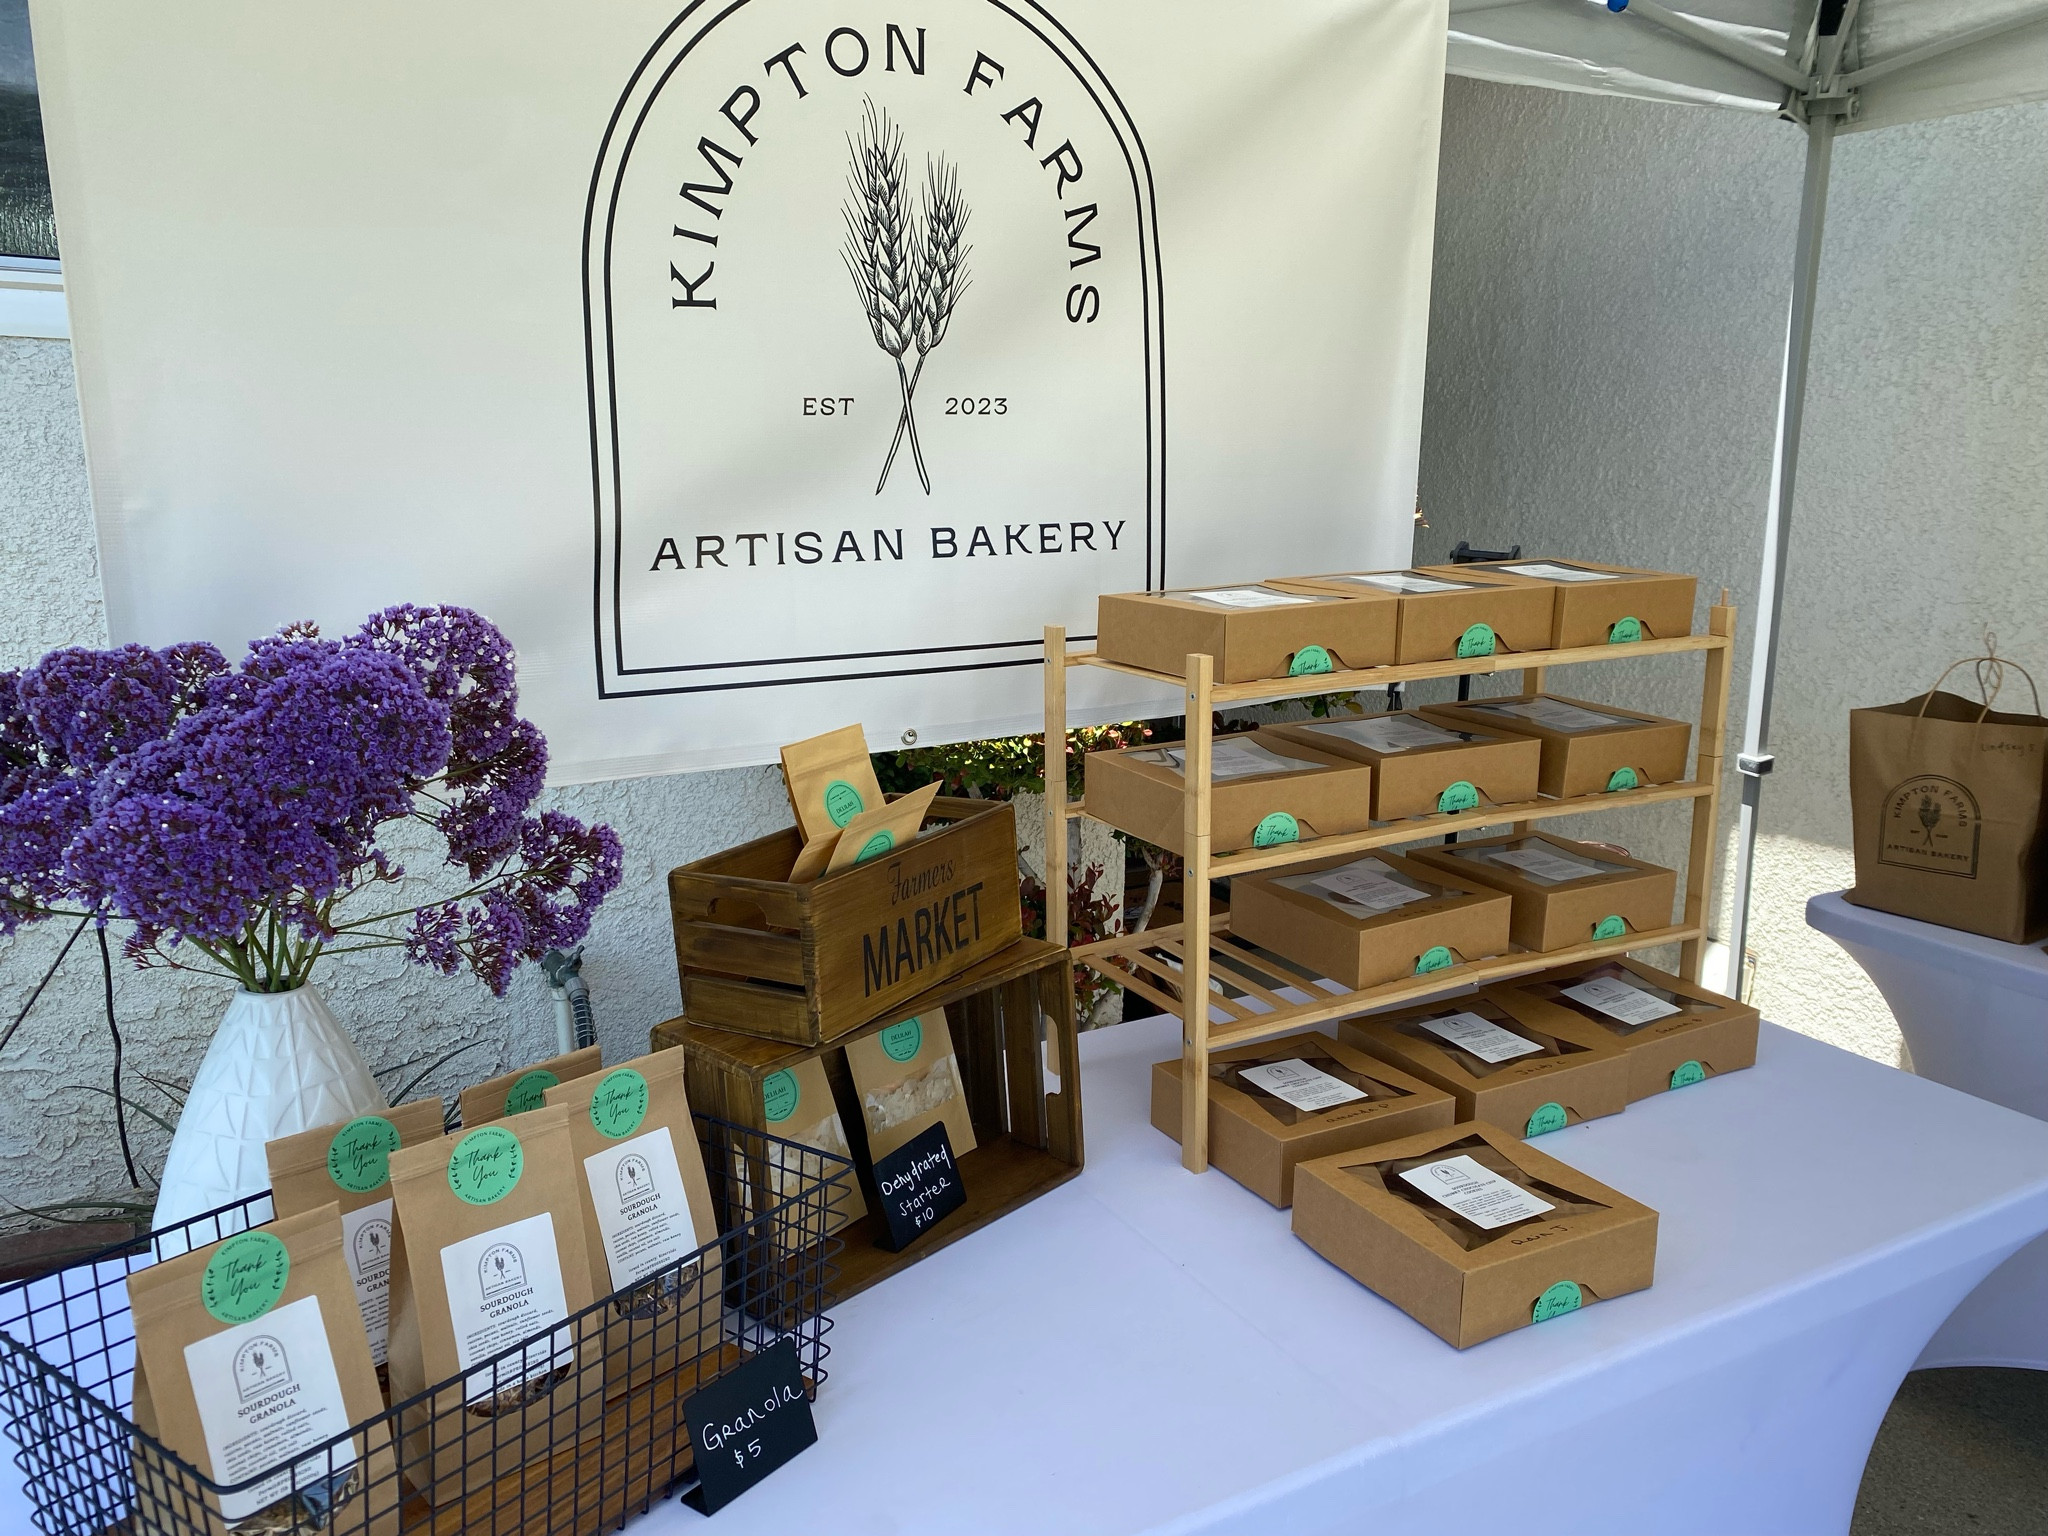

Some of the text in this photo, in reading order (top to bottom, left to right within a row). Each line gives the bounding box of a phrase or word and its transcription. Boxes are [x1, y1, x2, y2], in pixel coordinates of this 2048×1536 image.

[670, 23, 1102, 324] KIMPTON FARMS
[802, 397, 1009, 416] EST 2023
[649, 519, 1127, 572] ARTISAN BAKERY
[1893, 785, 1968, 827] KIMPTON FARMS
[1267, 825, 1288, 837] Thank
[1887, 844, 1970, 862] ARTISAN BAKERY
[887, 860, 956, 906] Farmers
[863, 881, 984, 998] MARKET
[604, 1086, 634, 1107] Thank
[609, 1103, 630, 1125] You
[343, 1134, 382, 1158] Thank
[464, 1146, 503, 1169] Thank
[353, 1154, 378, 1177] You
[473, 1165, 499, 1189] You
[881, 1143, 952, 1196] Dehydrated
[620, 1192, 661, 1216] SOURDOUGH
[627, 1204, 658, 1221] GRANOLA
[914, 1207, 934, 1228] $10
[221, 1253, 267, 1282] Thank
[356, 1268, 390, 1287] SOURDO
[230, 1278, 261, 1305] You
[366, 1278, 390, 1293] GRAN
[480, 1287, 534, 1313] SOURDOUGH
[489, 1299, 530, 1319] GRANOLA
[1544, 1296, 1570, 1311] Thank
[237, 1383, 301, 1418] SOURDOUGH
[249, 1398, 296, 1424] GRANOLA
[733, 1438, 762, 1469] $5
